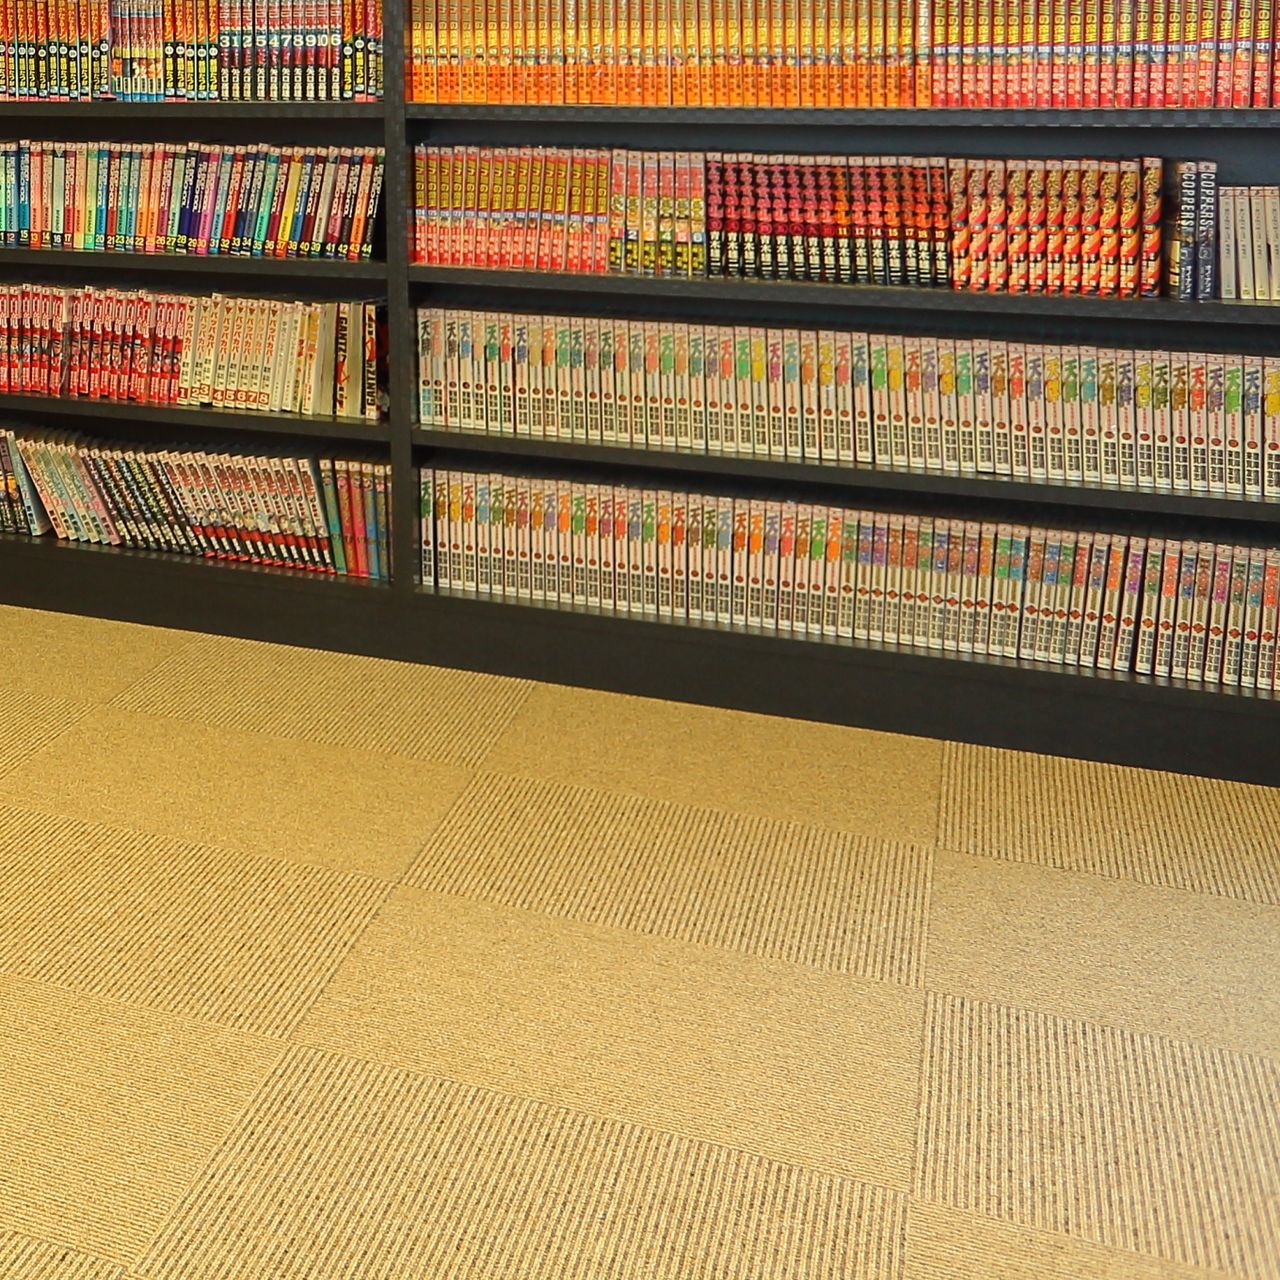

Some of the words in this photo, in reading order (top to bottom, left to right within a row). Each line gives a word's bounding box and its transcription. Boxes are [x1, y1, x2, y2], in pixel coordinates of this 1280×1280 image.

[221, 35, 230, 48] 3
[232, 36, 239, 47] 1
[243, 35, 252, 47] 2
[256, 35, 267, 47] 5
[269, 35, 279, 47] 4
[281, 35, 292, 47] 7
[293, 35, 303, 47] 8
[306, 35, 316, 47] 9
[318, 35, 328, 46] 10
[331, 35, 341, 46] 6
[1182, 173, 1196, 229] COPPERS
[1200, 173, 1215, 227] COPPERS
[21, 230, 28, 238] 15
[65, 233, 72, 241] 17
[96, 234, 105, 242] 20
[116, 234, 125, 243] 23
[54, 235, 61, 243] 16
[156, 236, 165, 245] 26
[177, 235, 186, 243] 28
[232, 239, 241, 247] 33
[242, 238, 251, 246] 34
[277, 241, 286, 249] 37
[338, 244, 347, 253] 42
[362, 244, 372, 253] 44
[338, 317, 347, 356] GANTZ
[180, 388, 187, 397] 1
[192, 389, 199, 397] 2
[200, 384, 208, 393] 3
[214, 390, 222, 399] 4
[226, 391, 234, 400] 5
[238, 391, 246, 399] 6
[248, 392, 256, 401] 7
[260, 394, 268, 402] 8
